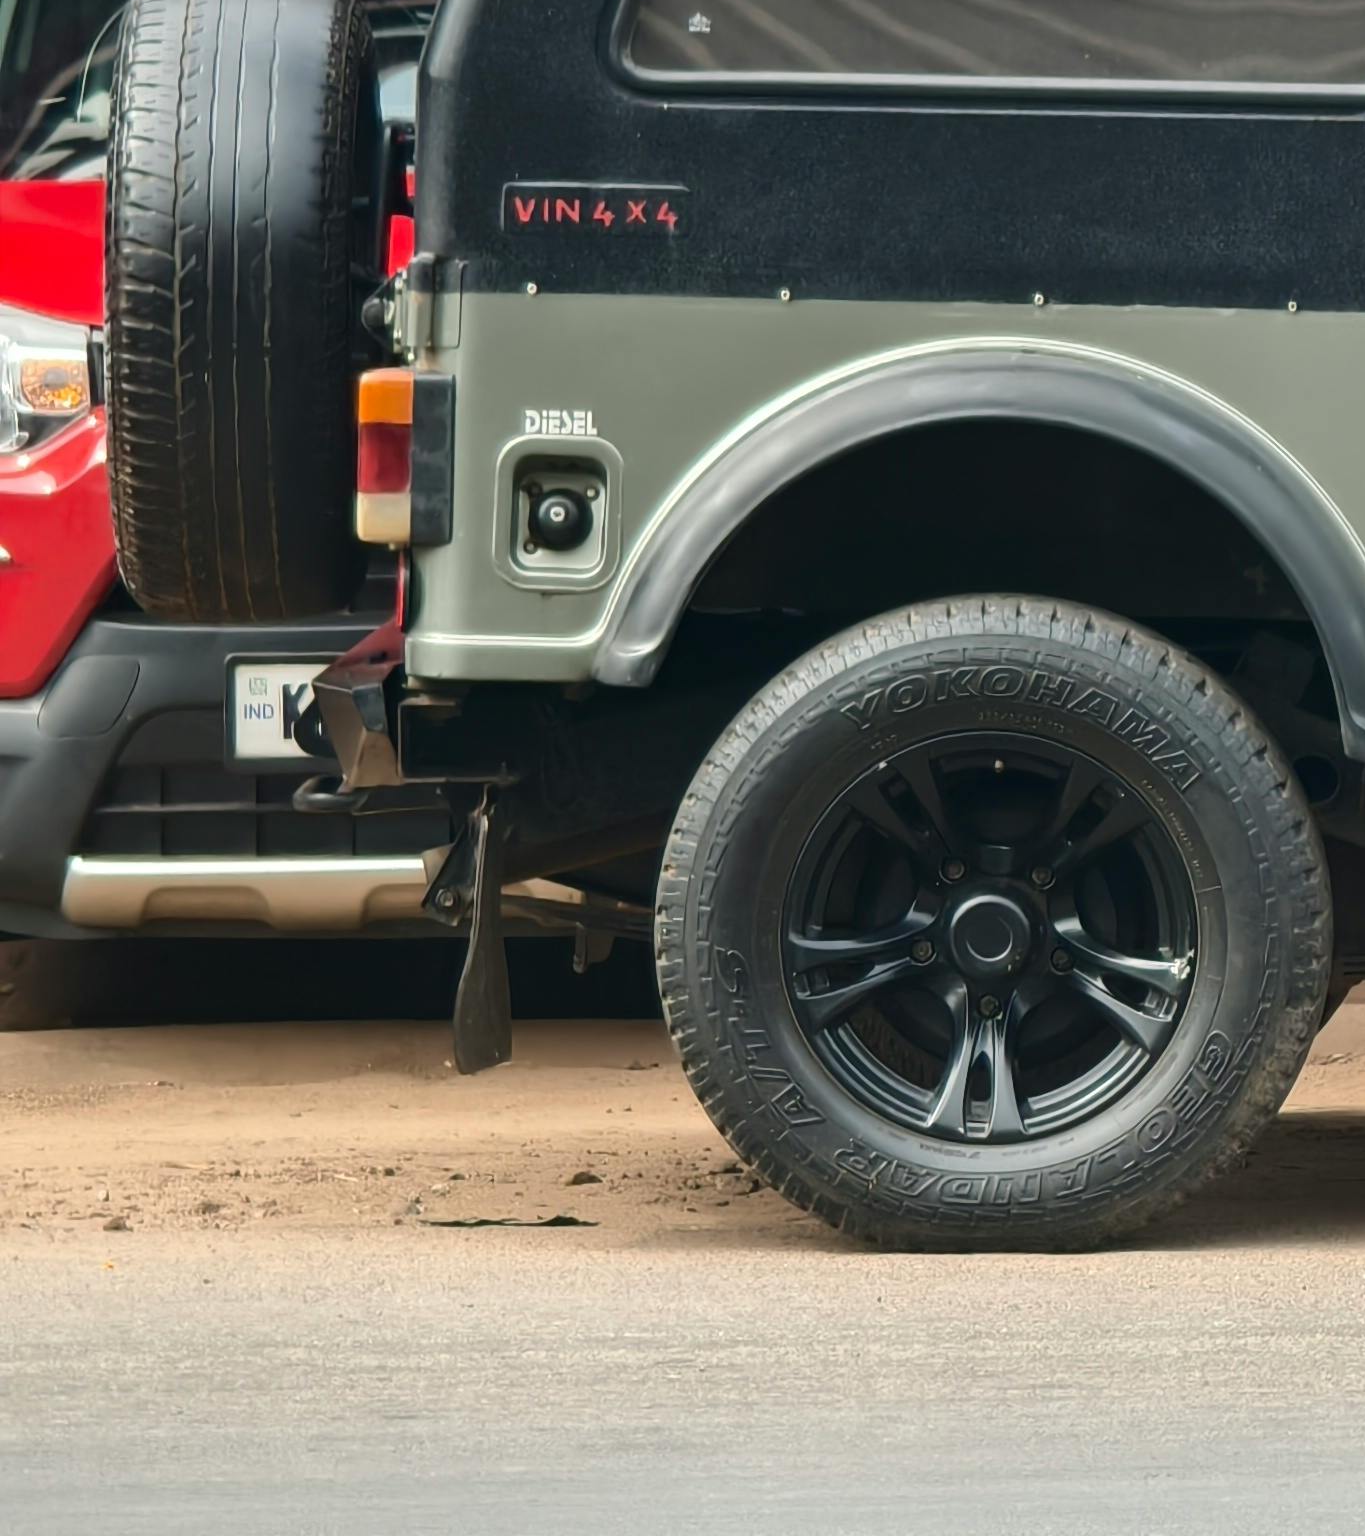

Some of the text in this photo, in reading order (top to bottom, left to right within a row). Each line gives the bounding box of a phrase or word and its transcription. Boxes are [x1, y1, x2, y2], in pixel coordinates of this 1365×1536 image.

[525, 409, 598, 435] DIESEL
[244, 703, 274, 720] IND
[840, 666, 1202, 792] YOKOHAMA
[832, 1030, 1231, 1205] GEOLANDAR
